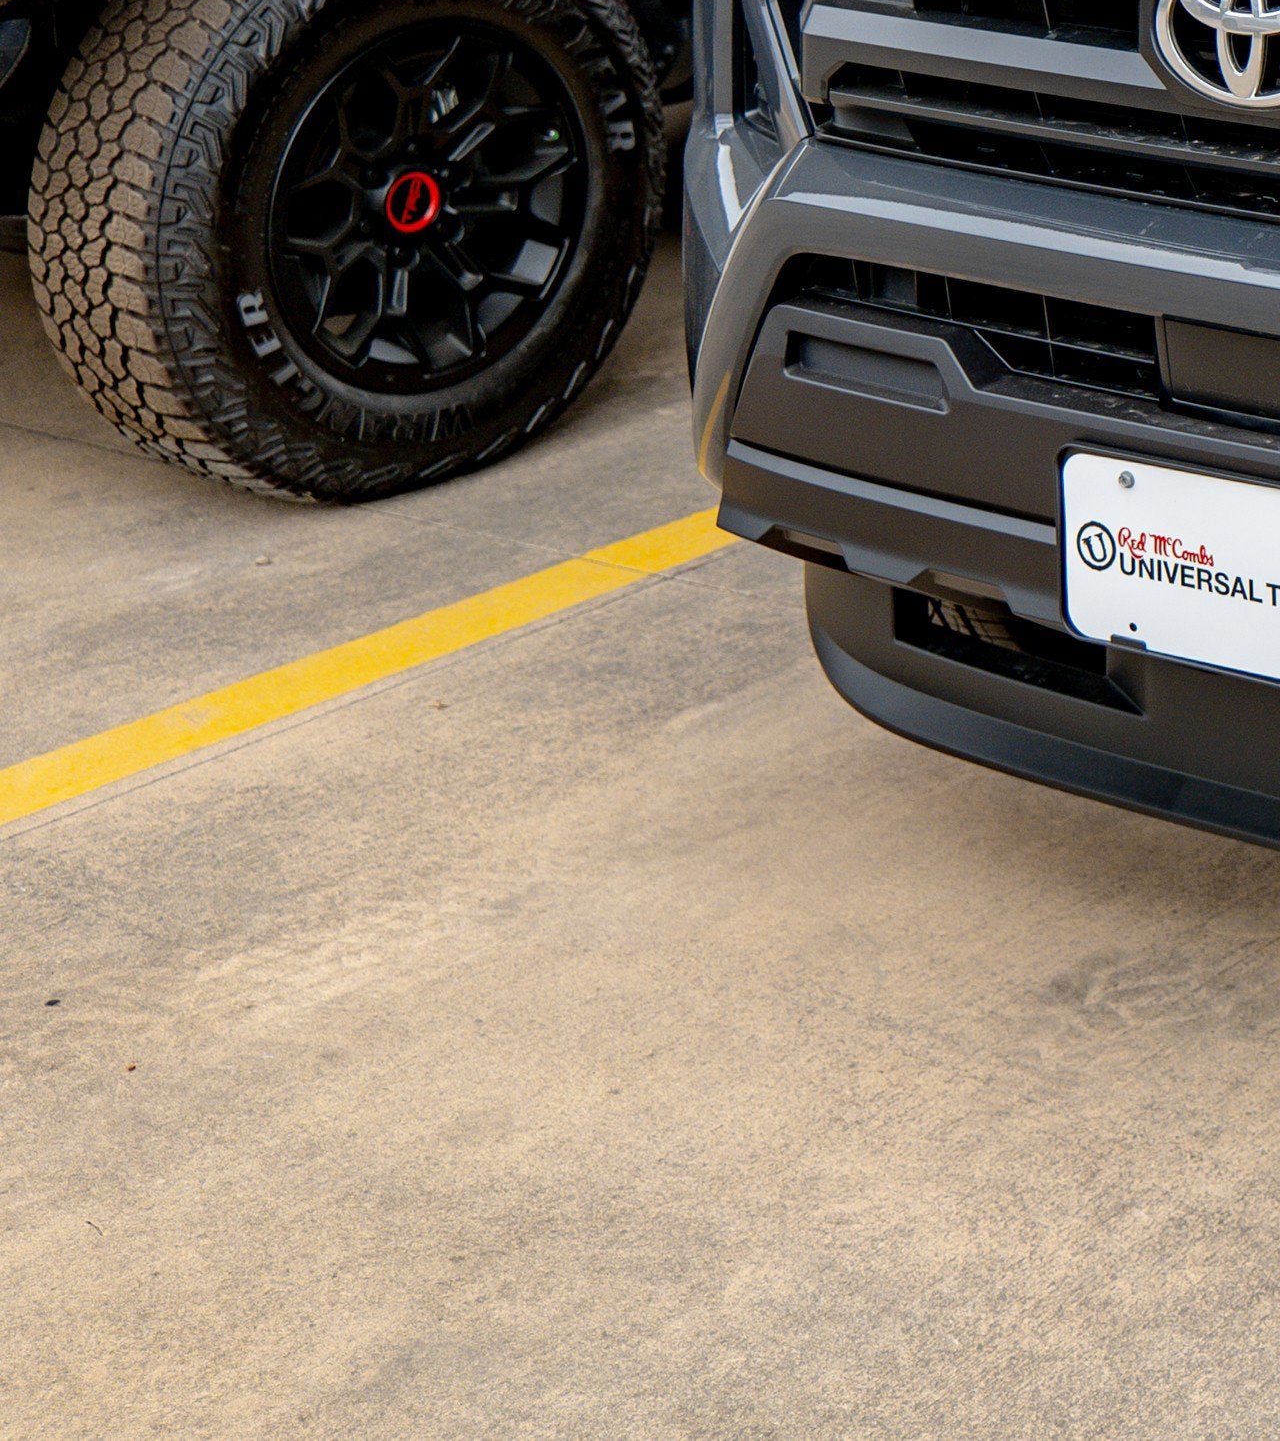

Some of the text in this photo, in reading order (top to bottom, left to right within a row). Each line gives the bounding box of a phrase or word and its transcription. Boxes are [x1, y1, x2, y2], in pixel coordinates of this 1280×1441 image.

[1117, 526, 1214, 567] Red McCombs
[1119, 552, 1263, 604] UNIVERSAL
